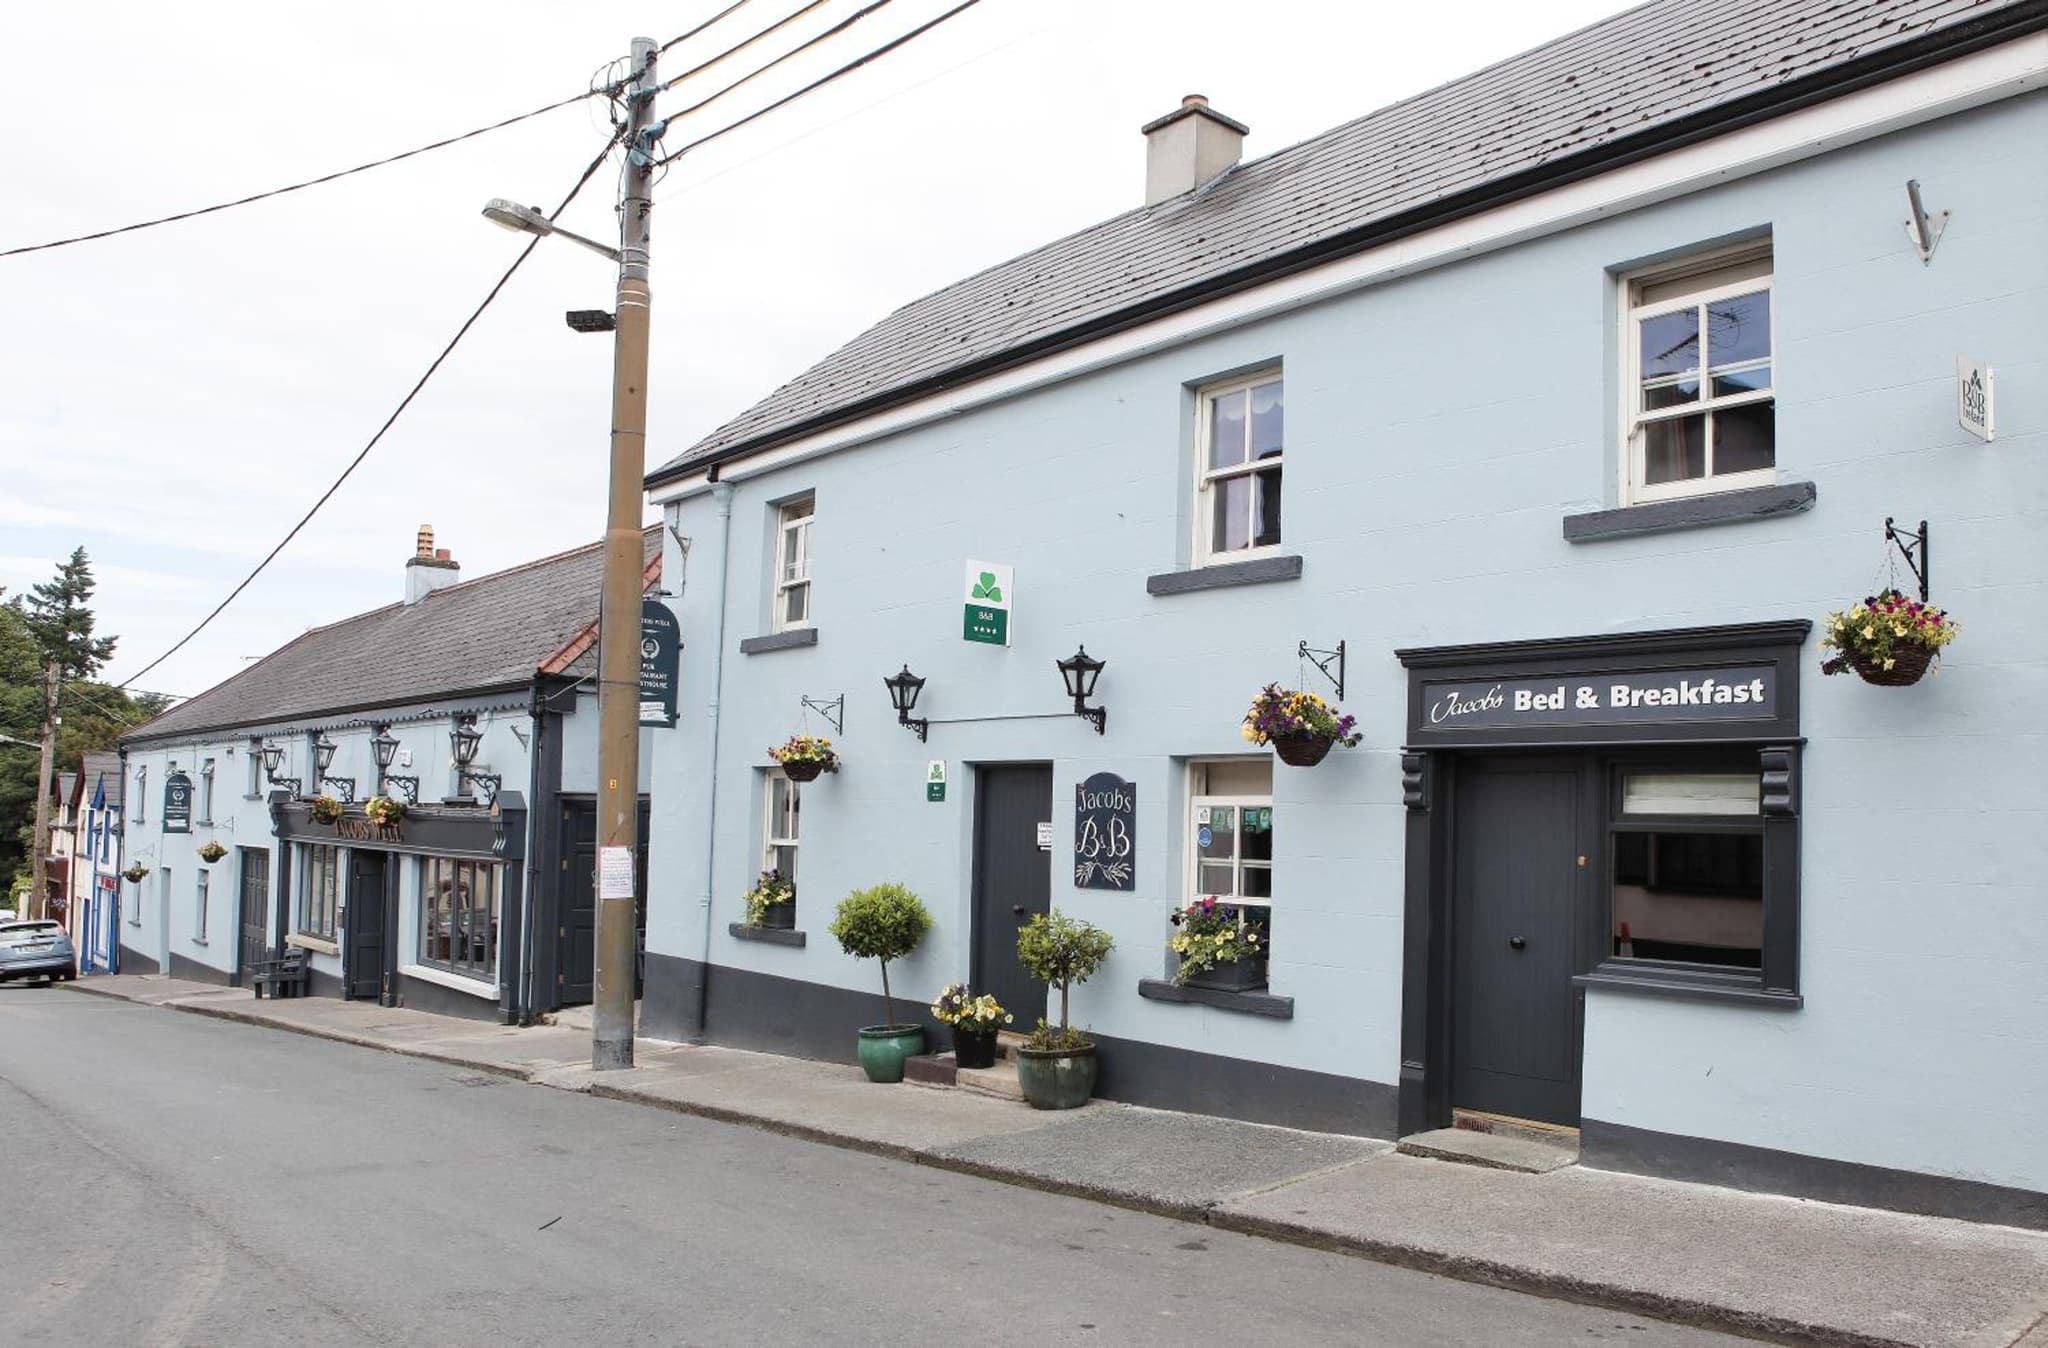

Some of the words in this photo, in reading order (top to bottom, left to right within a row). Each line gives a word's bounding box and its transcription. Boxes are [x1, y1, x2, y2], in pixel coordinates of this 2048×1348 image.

[1431, 684, 1504, 723] Jacob's
[1514, 686, 1566, 711] Bed
[1575, 686, 1600, 709] &
[1610, 678, 1765, 707] Breakfast
